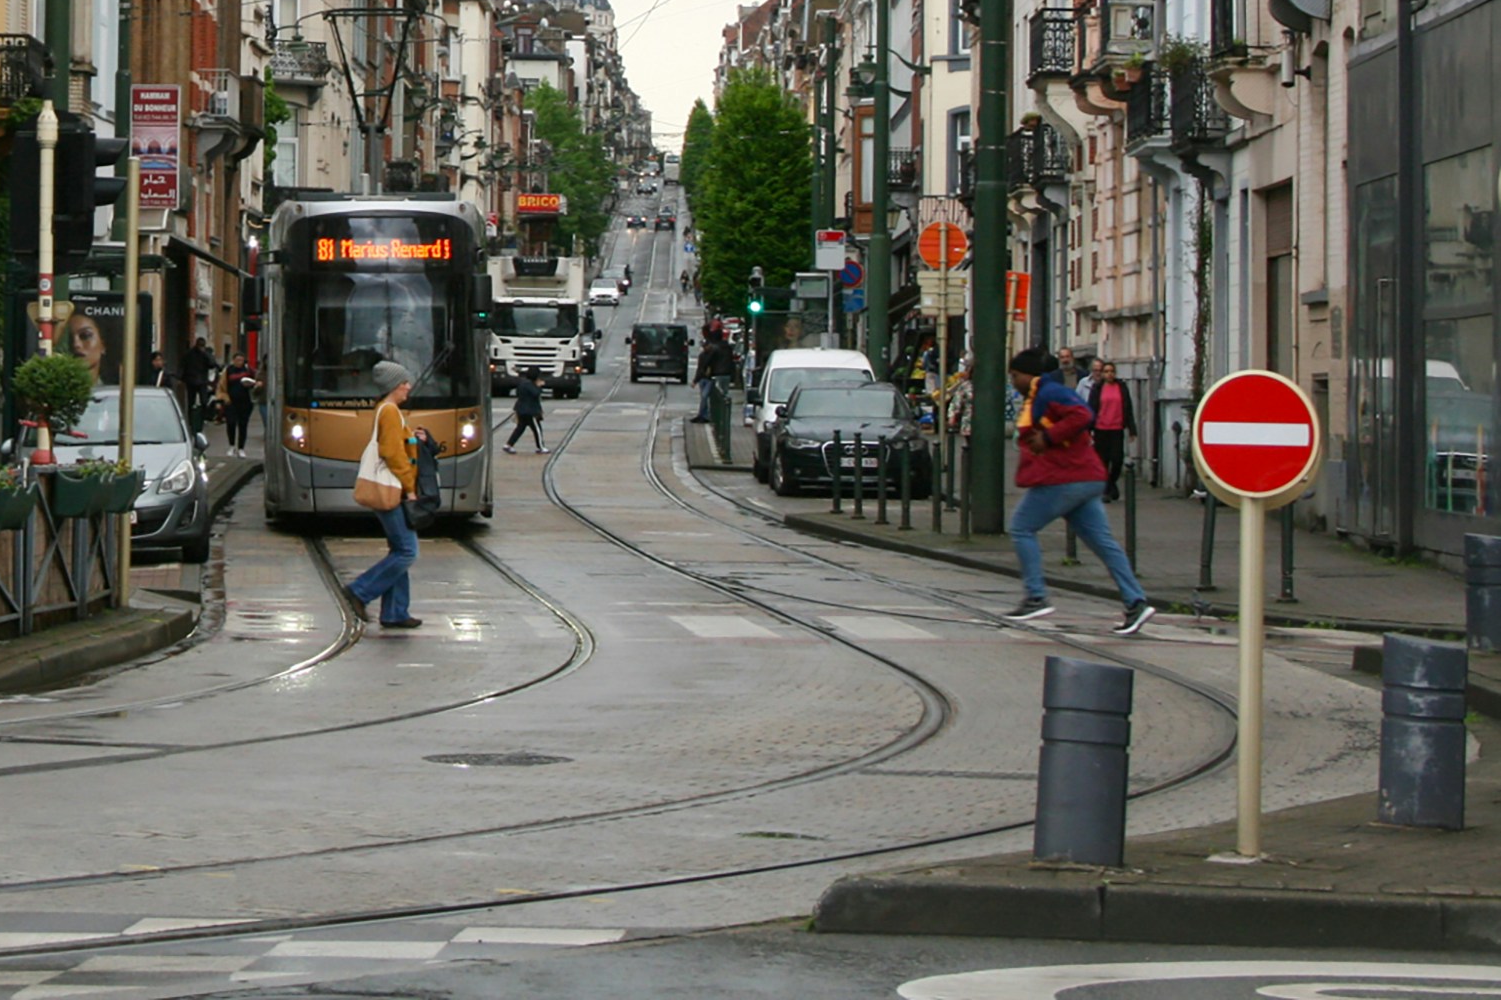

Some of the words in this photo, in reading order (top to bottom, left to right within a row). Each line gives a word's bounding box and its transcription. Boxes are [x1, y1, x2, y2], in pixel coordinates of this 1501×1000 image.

[518, 196, 559, 207] BRICO
[317, 238, 334, 261] 81
[341, 239, 388, 258] Marius
[390, 238, 441, 258] Renard
[85, 306, 125, 317] CHAN
